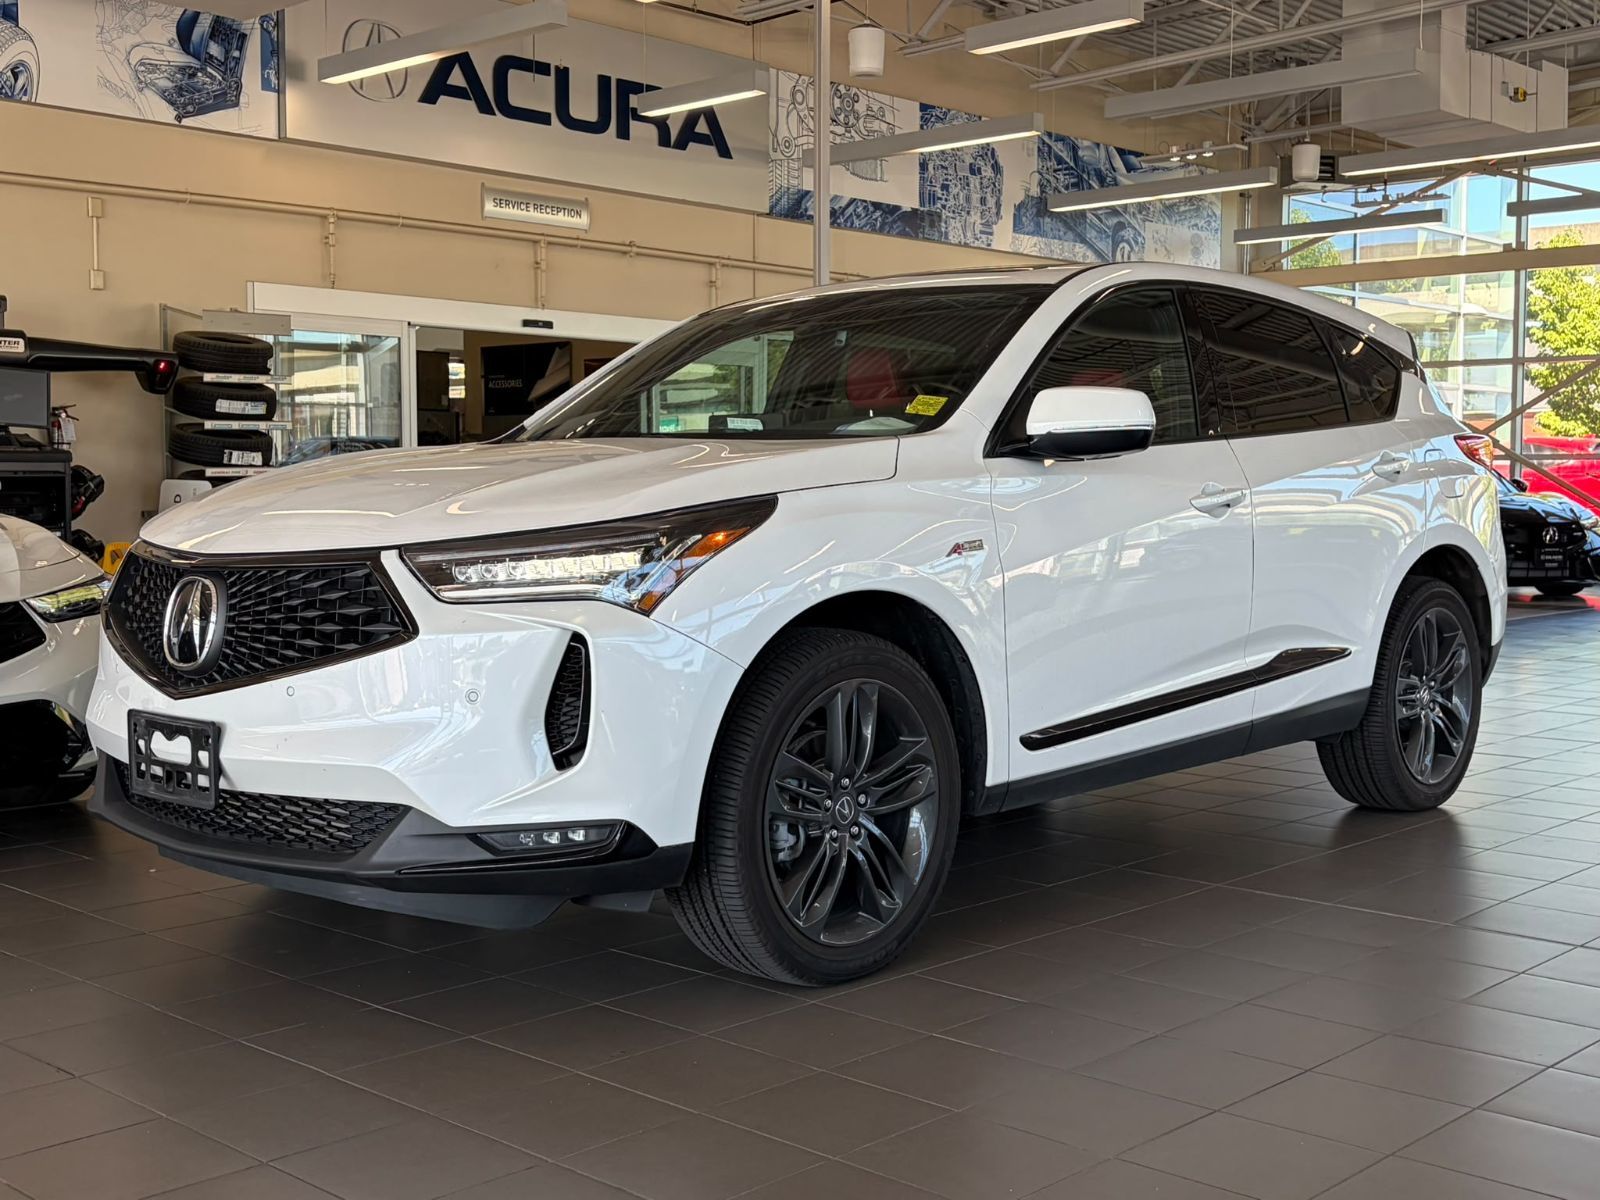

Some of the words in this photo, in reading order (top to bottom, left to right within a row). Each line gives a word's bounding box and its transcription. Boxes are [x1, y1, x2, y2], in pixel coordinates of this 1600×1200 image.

[418, 51, 733, 159] ACURA
[493, 198, 531, 212] SERVICE
[533, 203, 582, 218] RECEPTION
[488, 379, 523, 389] ACCESSORIES
